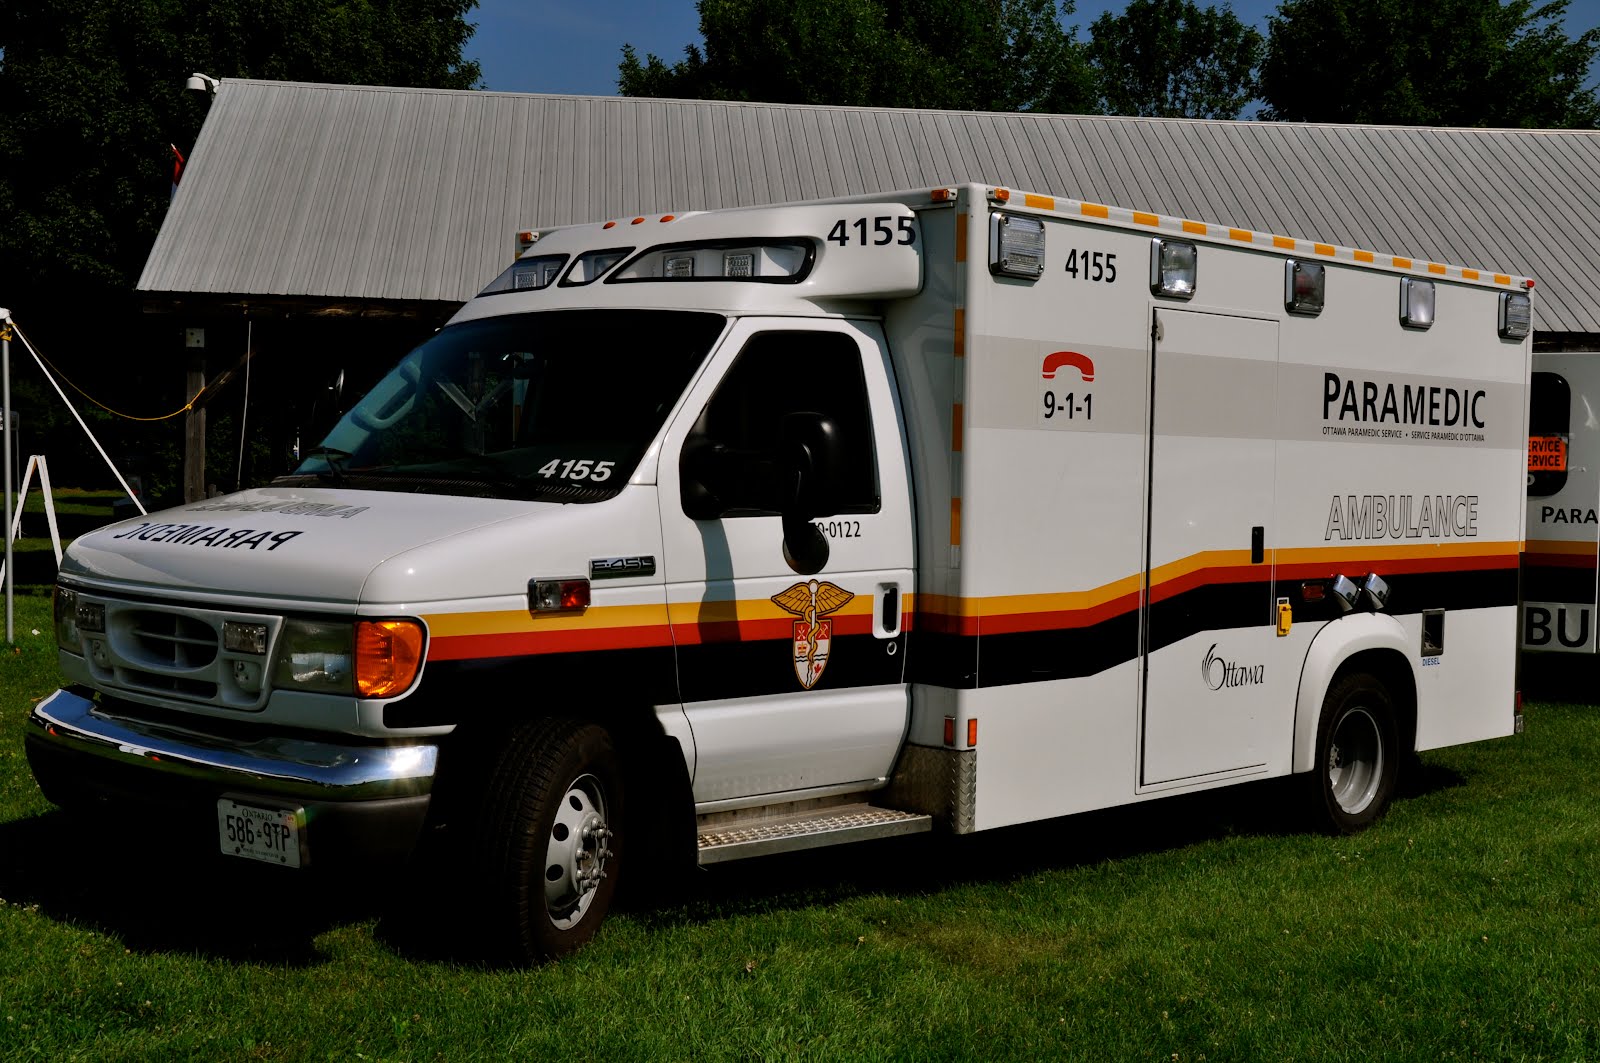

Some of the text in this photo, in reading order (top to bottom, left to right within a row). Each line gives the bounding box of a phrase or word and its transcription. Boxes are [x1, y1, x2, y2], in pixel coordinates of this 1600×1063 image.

[827, 216, 916, 246] 4155
[1065, 248, 1117, 283] 4155
[1043, 390, 1092, 420] 9-1-1
[1322, 426, 1346, 436] OTTAWA
[1347, 427, 1380, 438] PARAMEDIC
[1381, 429, 1402, 439] SERVICE
[1411, 430, 1430, 440] SERVICE
[538, 459, 615, 482] 4155
[1325, 495, 1478, 540] AMBULANCE
[1541, 506, 1598, 524] PARA
[1525, 607, 1589, 648] BU
[1202, 643, 1264, 691] Ottawa
[226, 815, 291, 852] 586 9TP
